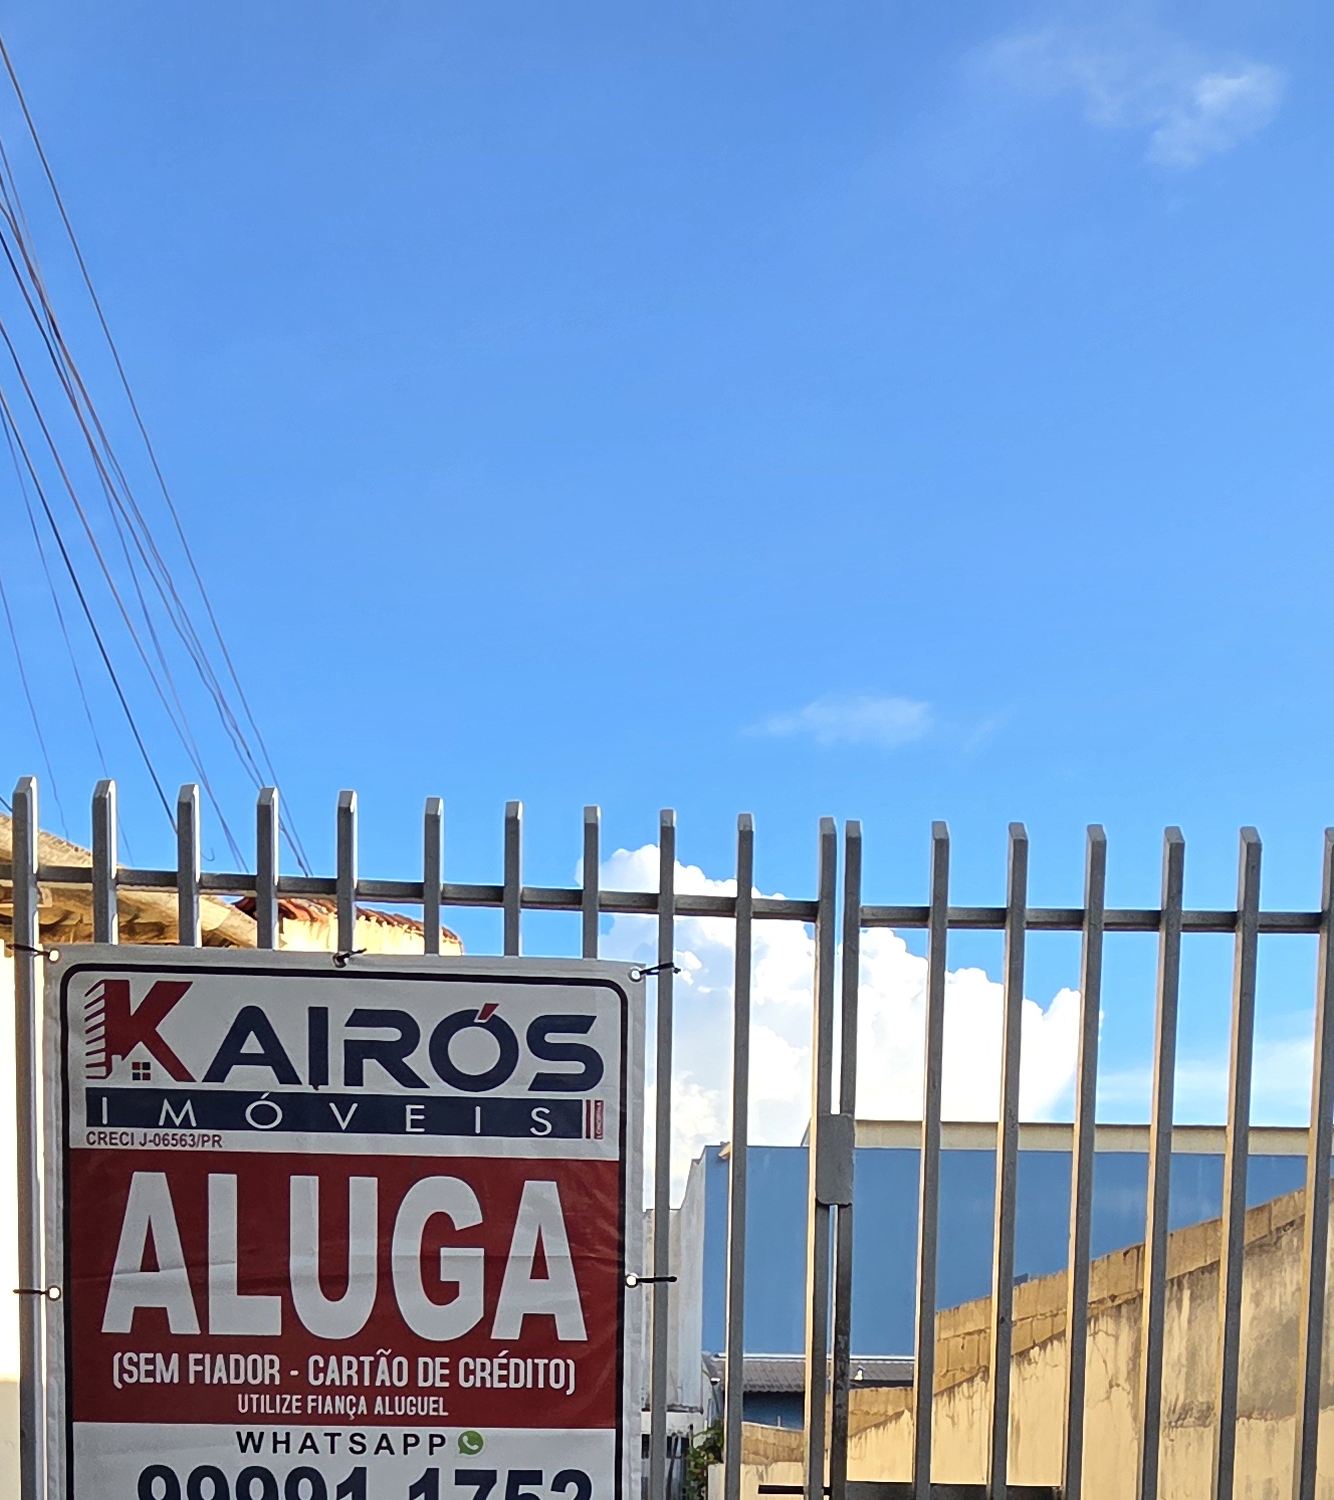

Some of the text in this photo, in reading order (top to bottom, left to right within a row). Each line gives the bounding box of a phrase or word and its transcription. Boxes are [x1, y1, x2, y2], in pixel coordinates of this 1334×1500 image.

[85, 979, 605, 1092] KAIRÓS
[101, 1092, 552, 1137] IMÓVEIS
[86, 1131, 223, 1148] CRECI J-06563/PR
[101, 1171, 588, 1342] ALUGA
[113, 1352, 179, 1389] (SEM
[188, 1353, 281, 1385] FIADOR
[308, 1348, 409, 1387] CARTÃO
[417, 1357, 450, 1387] DE
[458, 1350, 576, 1395] CRÉDITO)
[237, 1394, 449, 1420] UTILIZE FIANÇA ALUGUEL
[236, 1431, 447, 1457] WHATSAPP
